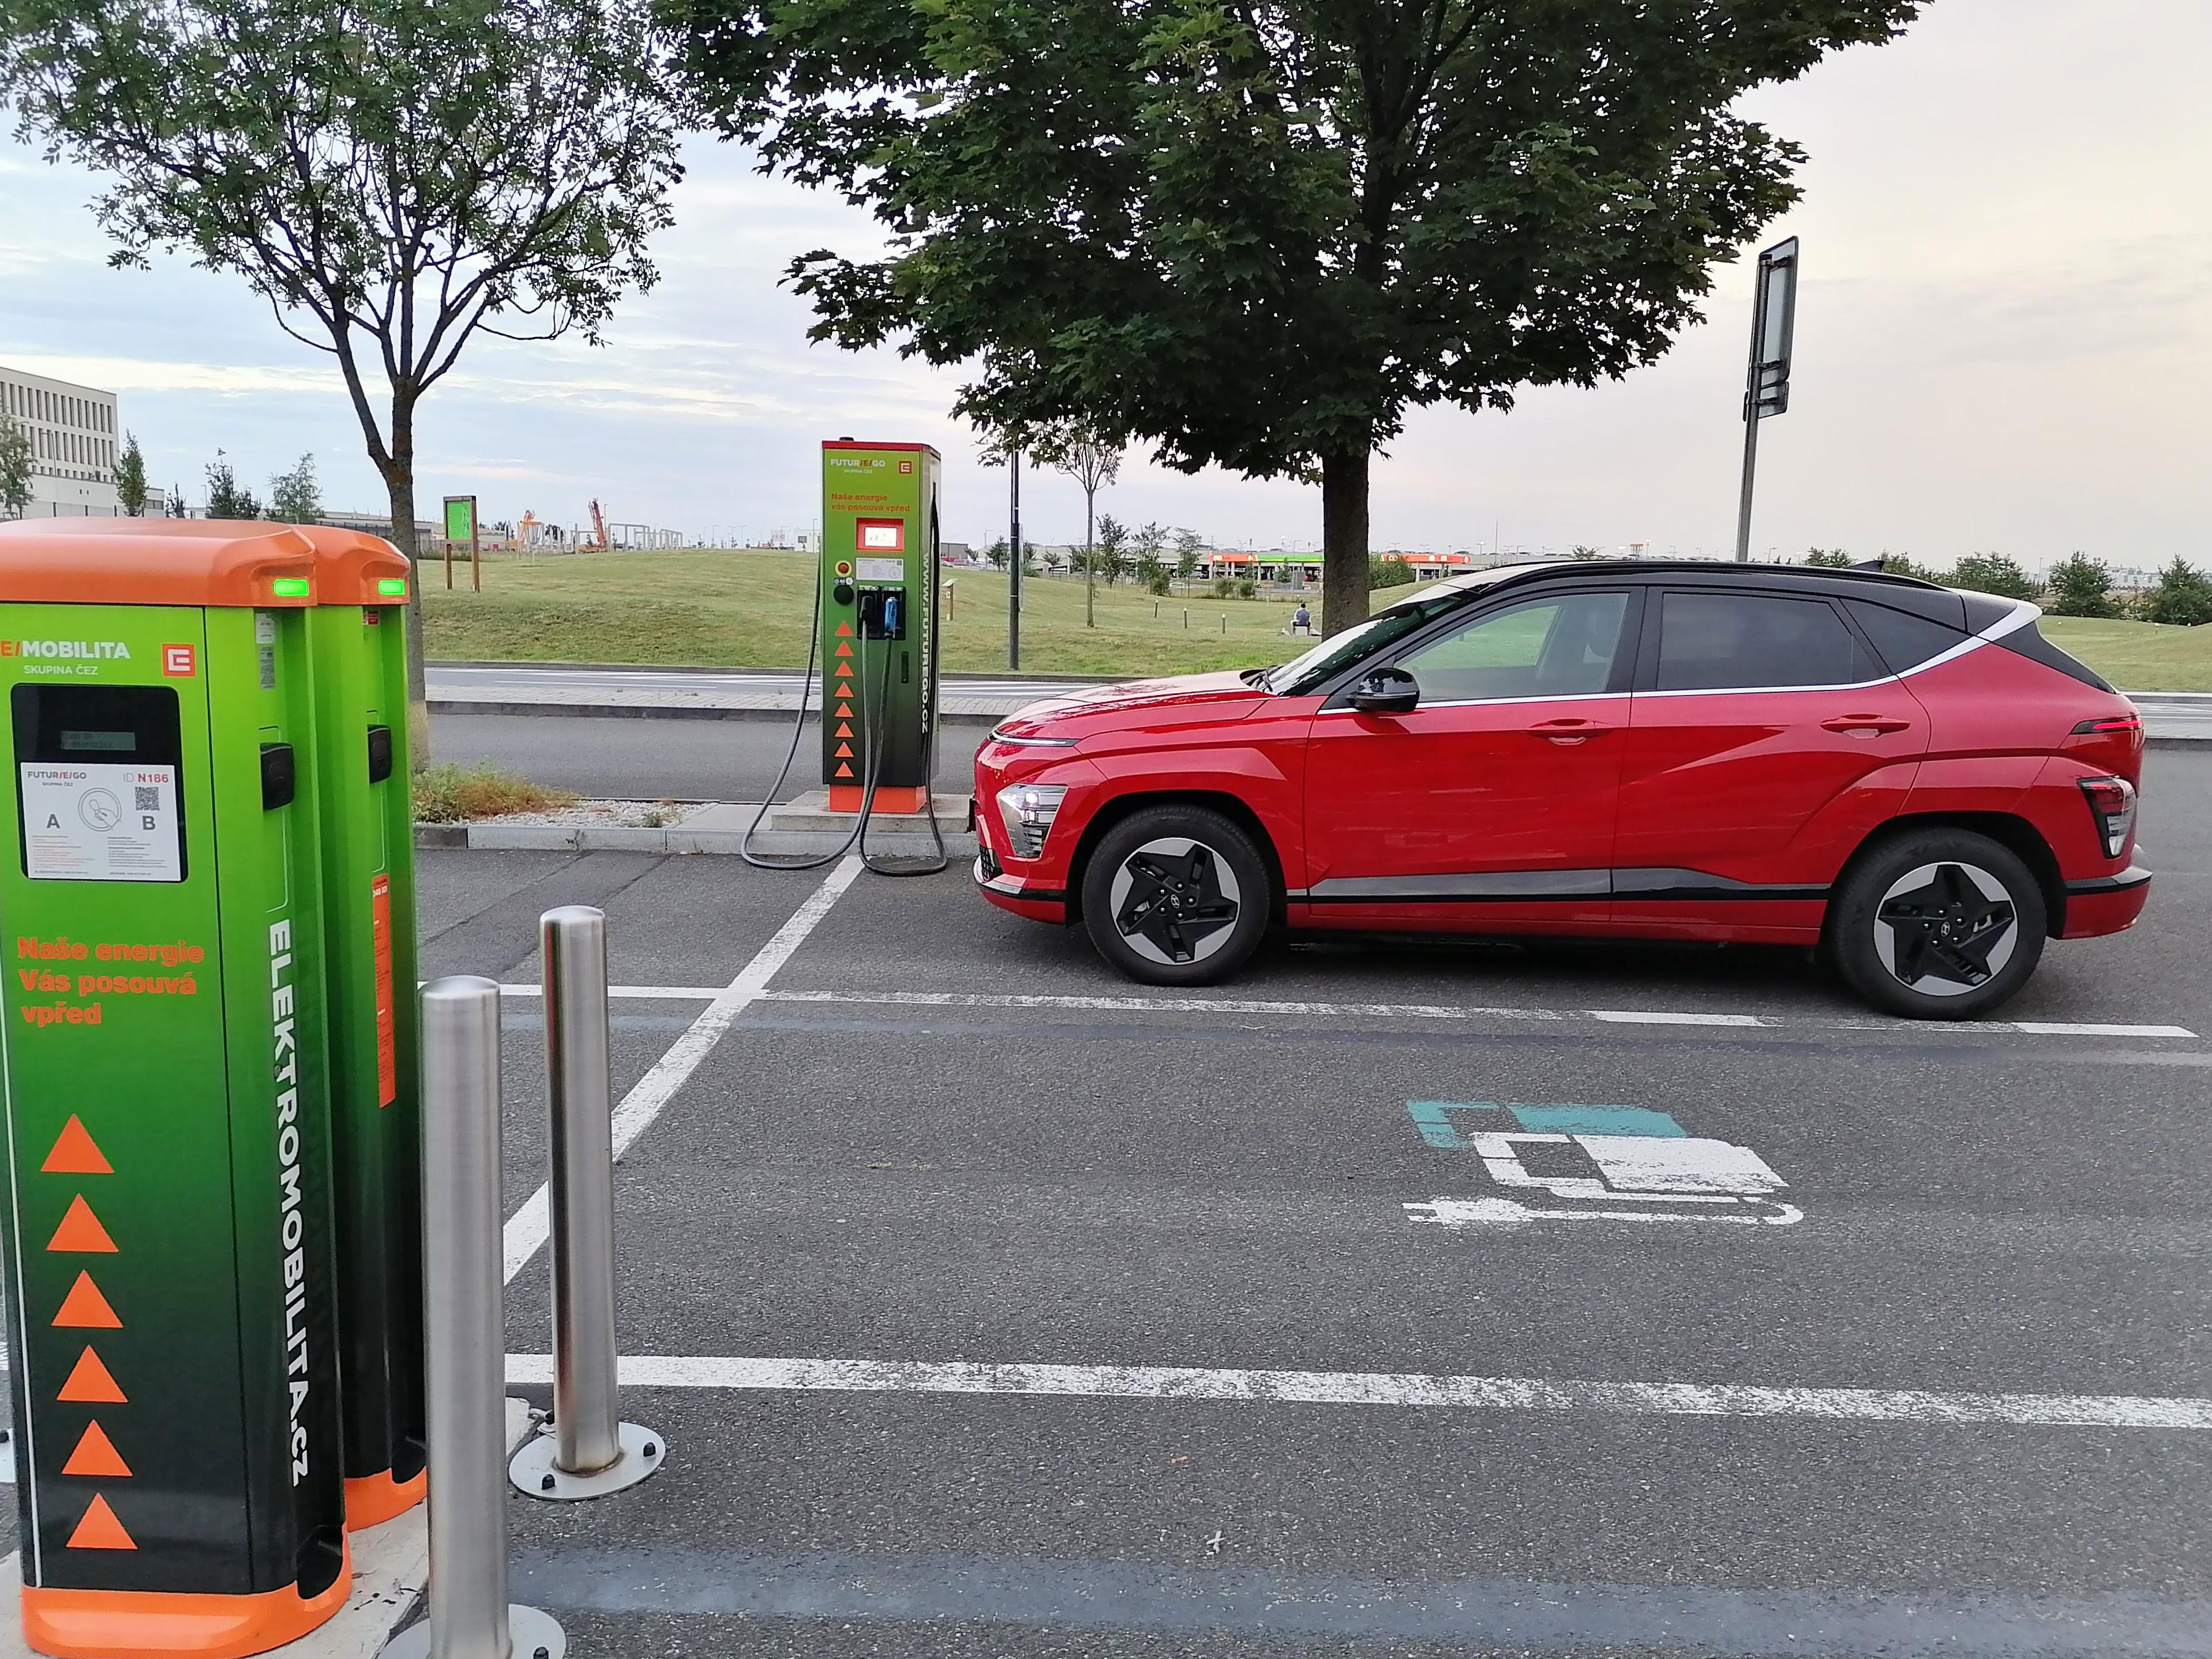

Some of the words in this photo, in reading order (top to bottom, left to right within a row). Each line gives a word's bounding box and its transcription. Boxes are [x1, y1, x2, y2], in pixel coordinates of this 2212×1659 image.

[24, 665, 73, 674] SKUPINA
[76, 664, 98, 675] ČEZ
[28, 771, 87, 779] FUTUR/E/GO
[123, 773, 134, 782] ID
[138, 774, 168, 783] N186
[46, 814, 61, 828] A
[142, 816, 156, 830] B
[17, 936, 88, 960] Naše
[95, 940, 204, 967] energie
[18, 969, 71, 992] Vás
[78, 971, 196, 997] posouvá
[21, 1001, 102, 1027] vpřed
